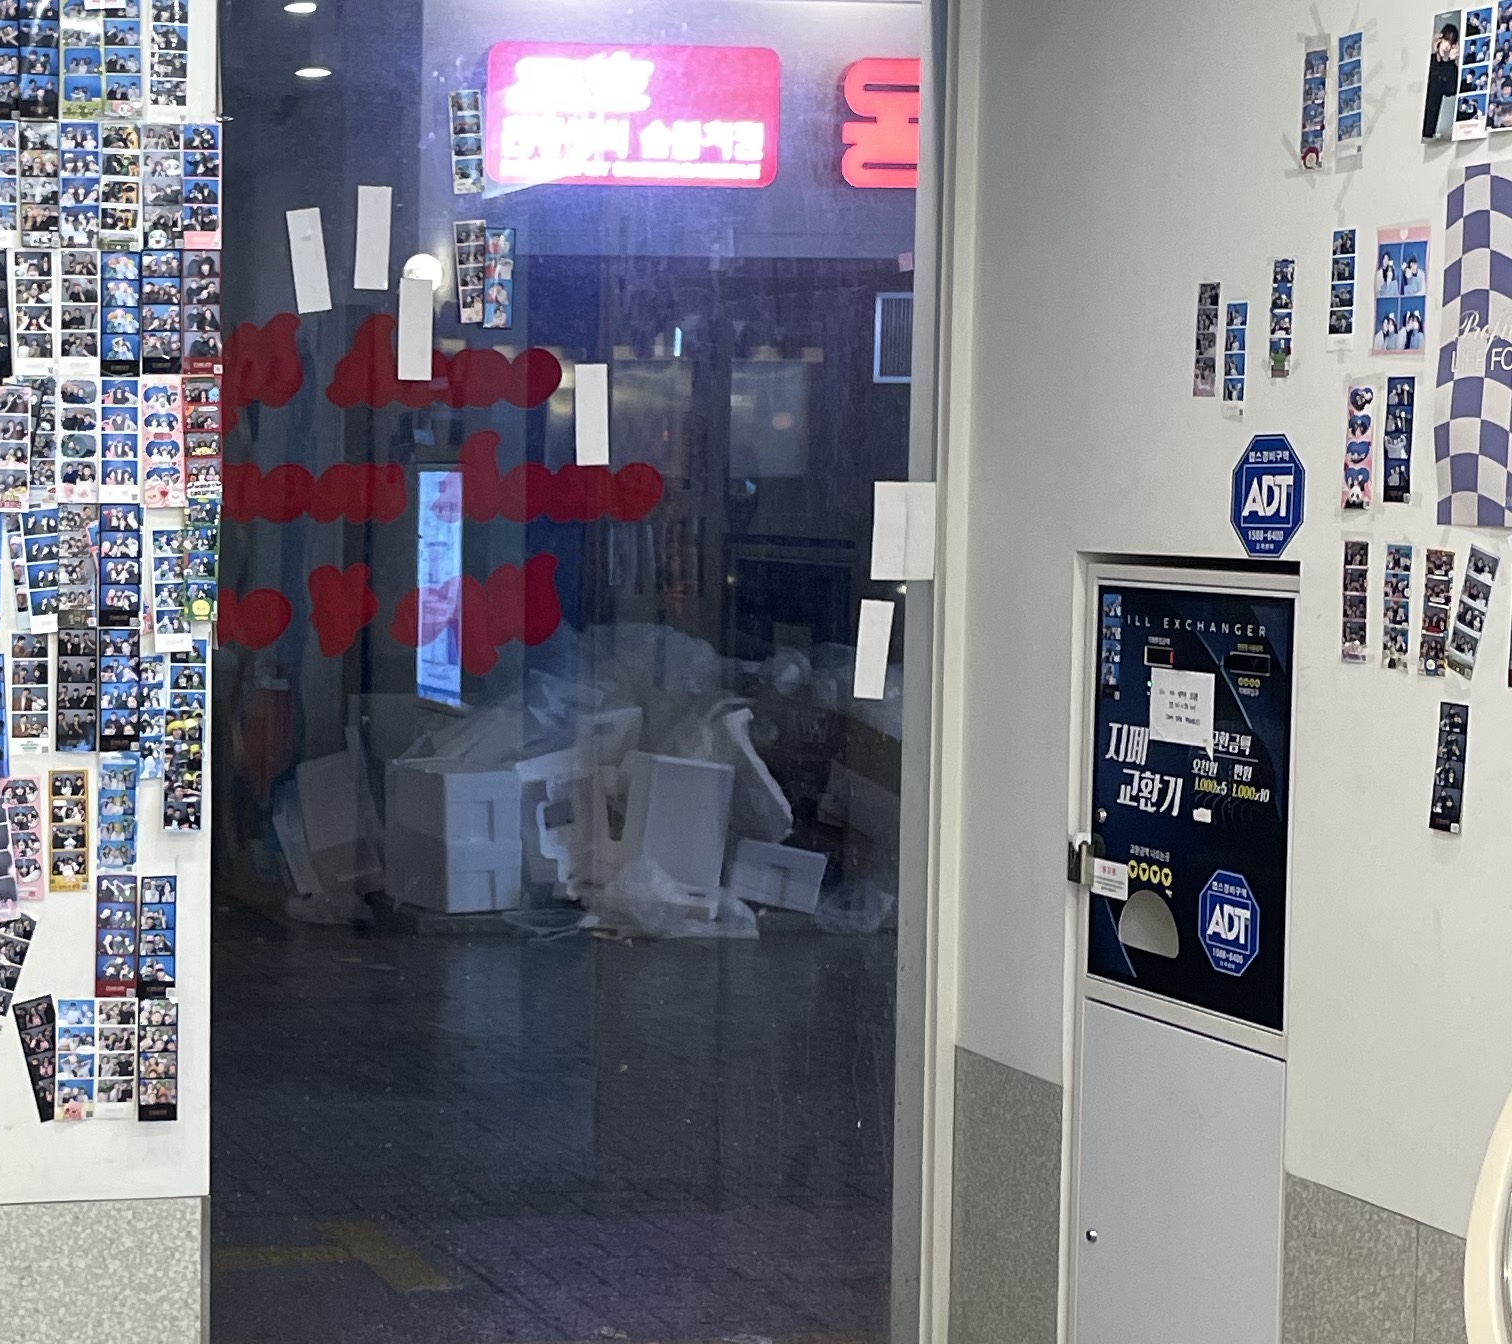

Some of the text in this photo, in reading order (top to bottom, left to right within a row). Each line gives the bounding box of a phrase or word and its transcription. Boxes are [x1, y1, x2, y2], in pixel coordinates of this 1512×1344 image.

[1241, 474, 1294, 517] ADT
[1126, 614, 1267, 638] ILL EXCHANGER
[1105, 722, 1150, 766] 지폐
[1191, 758, 1253, 782] 오천원 만원
[1117, 767, 1184, 817] 교환기
[1206, 903, 1251, 944] ADT
